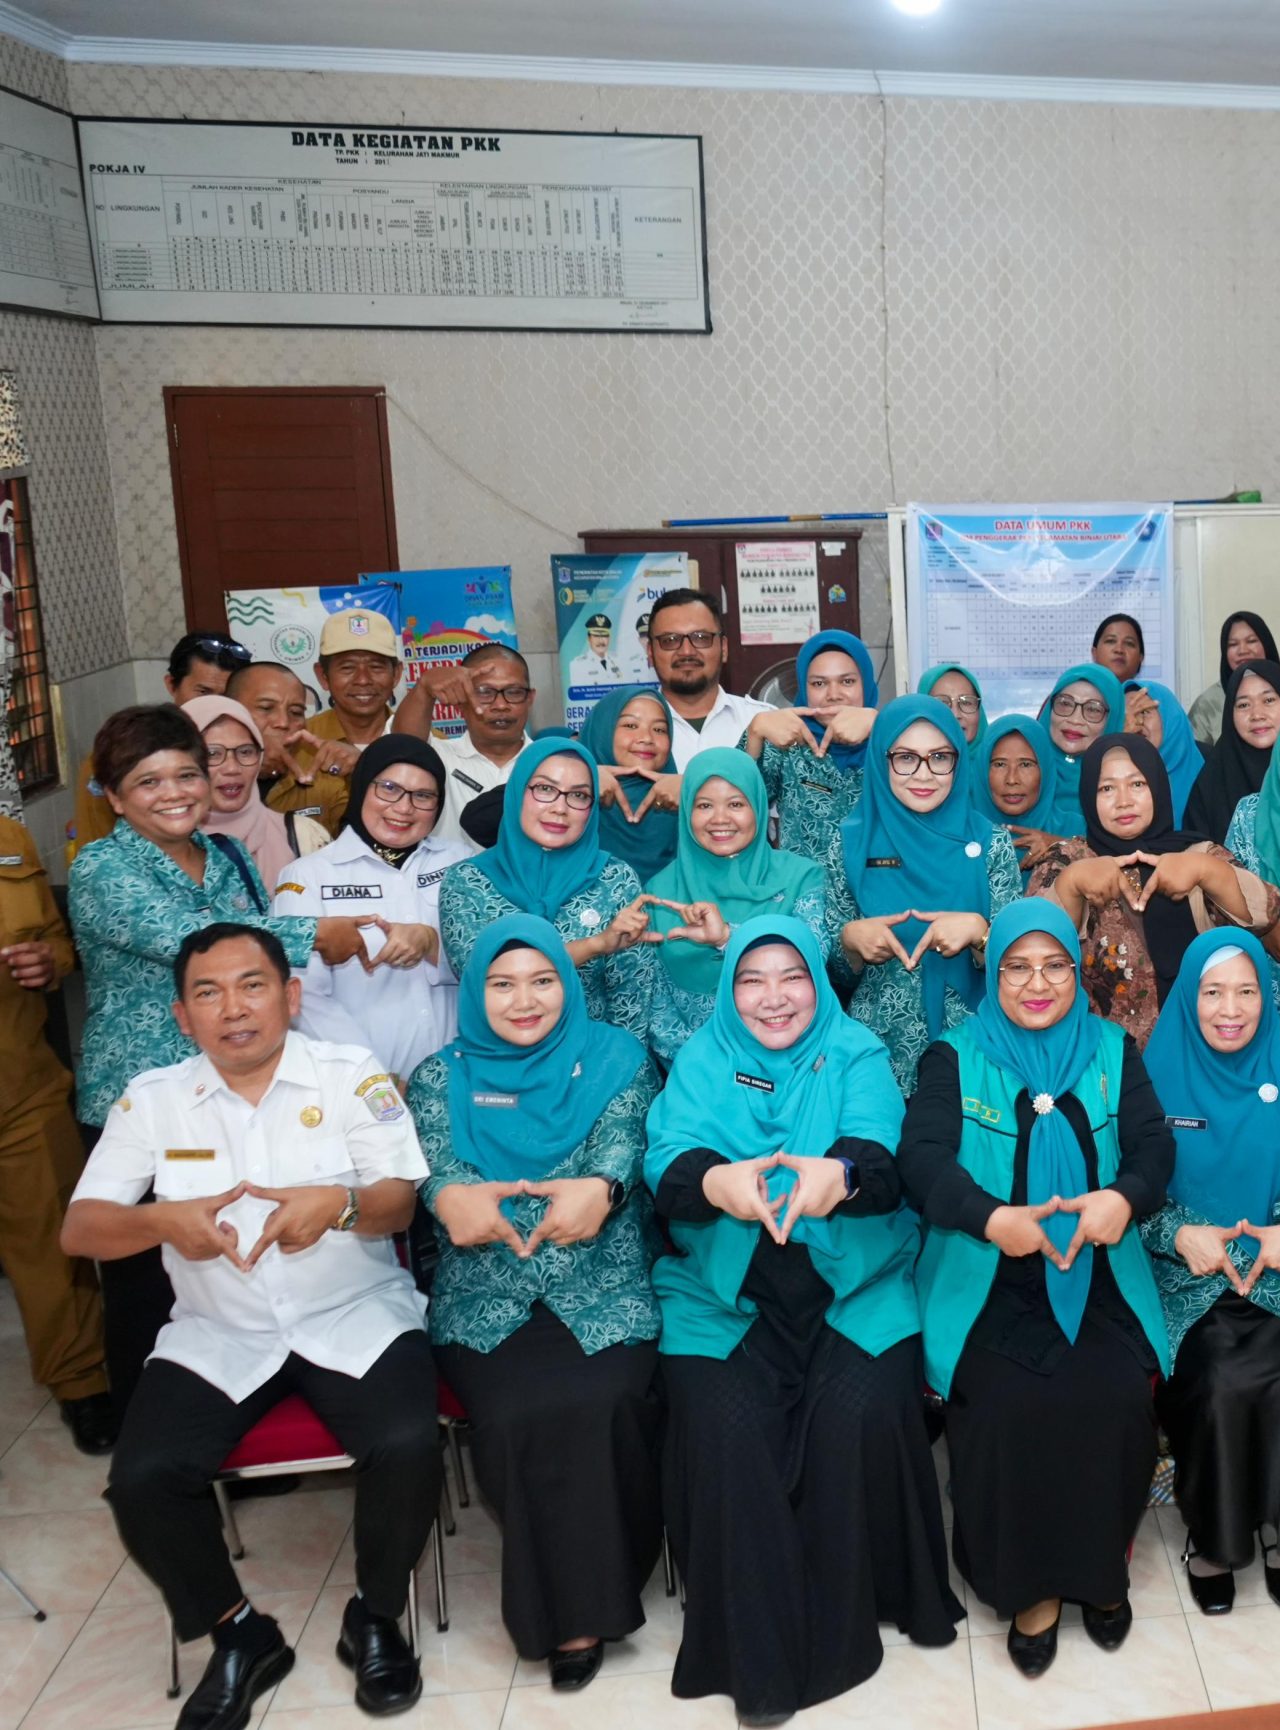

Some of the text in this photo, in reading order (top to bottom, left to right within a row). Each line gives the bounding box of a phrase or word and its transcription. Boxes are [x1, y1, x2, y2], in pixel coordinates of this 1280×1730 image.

[291, 131, 502, 152] DATA KEGIATAN PKK
[373, 150, 414, 158] KELURAHAN
[430, 151, 460, 159] MAKMUR
[89, 164, 146, 174] POKJA IV
[110, 204, 161, 212] LINGKUNGAN
[995, 520, 1092, 531] DATA UMUM PKK
[975, 533, 1018, 542] PENGGERAK
[415, 643, 463, 657] TERJADI
[331, 887, 372, 898] DIANA
